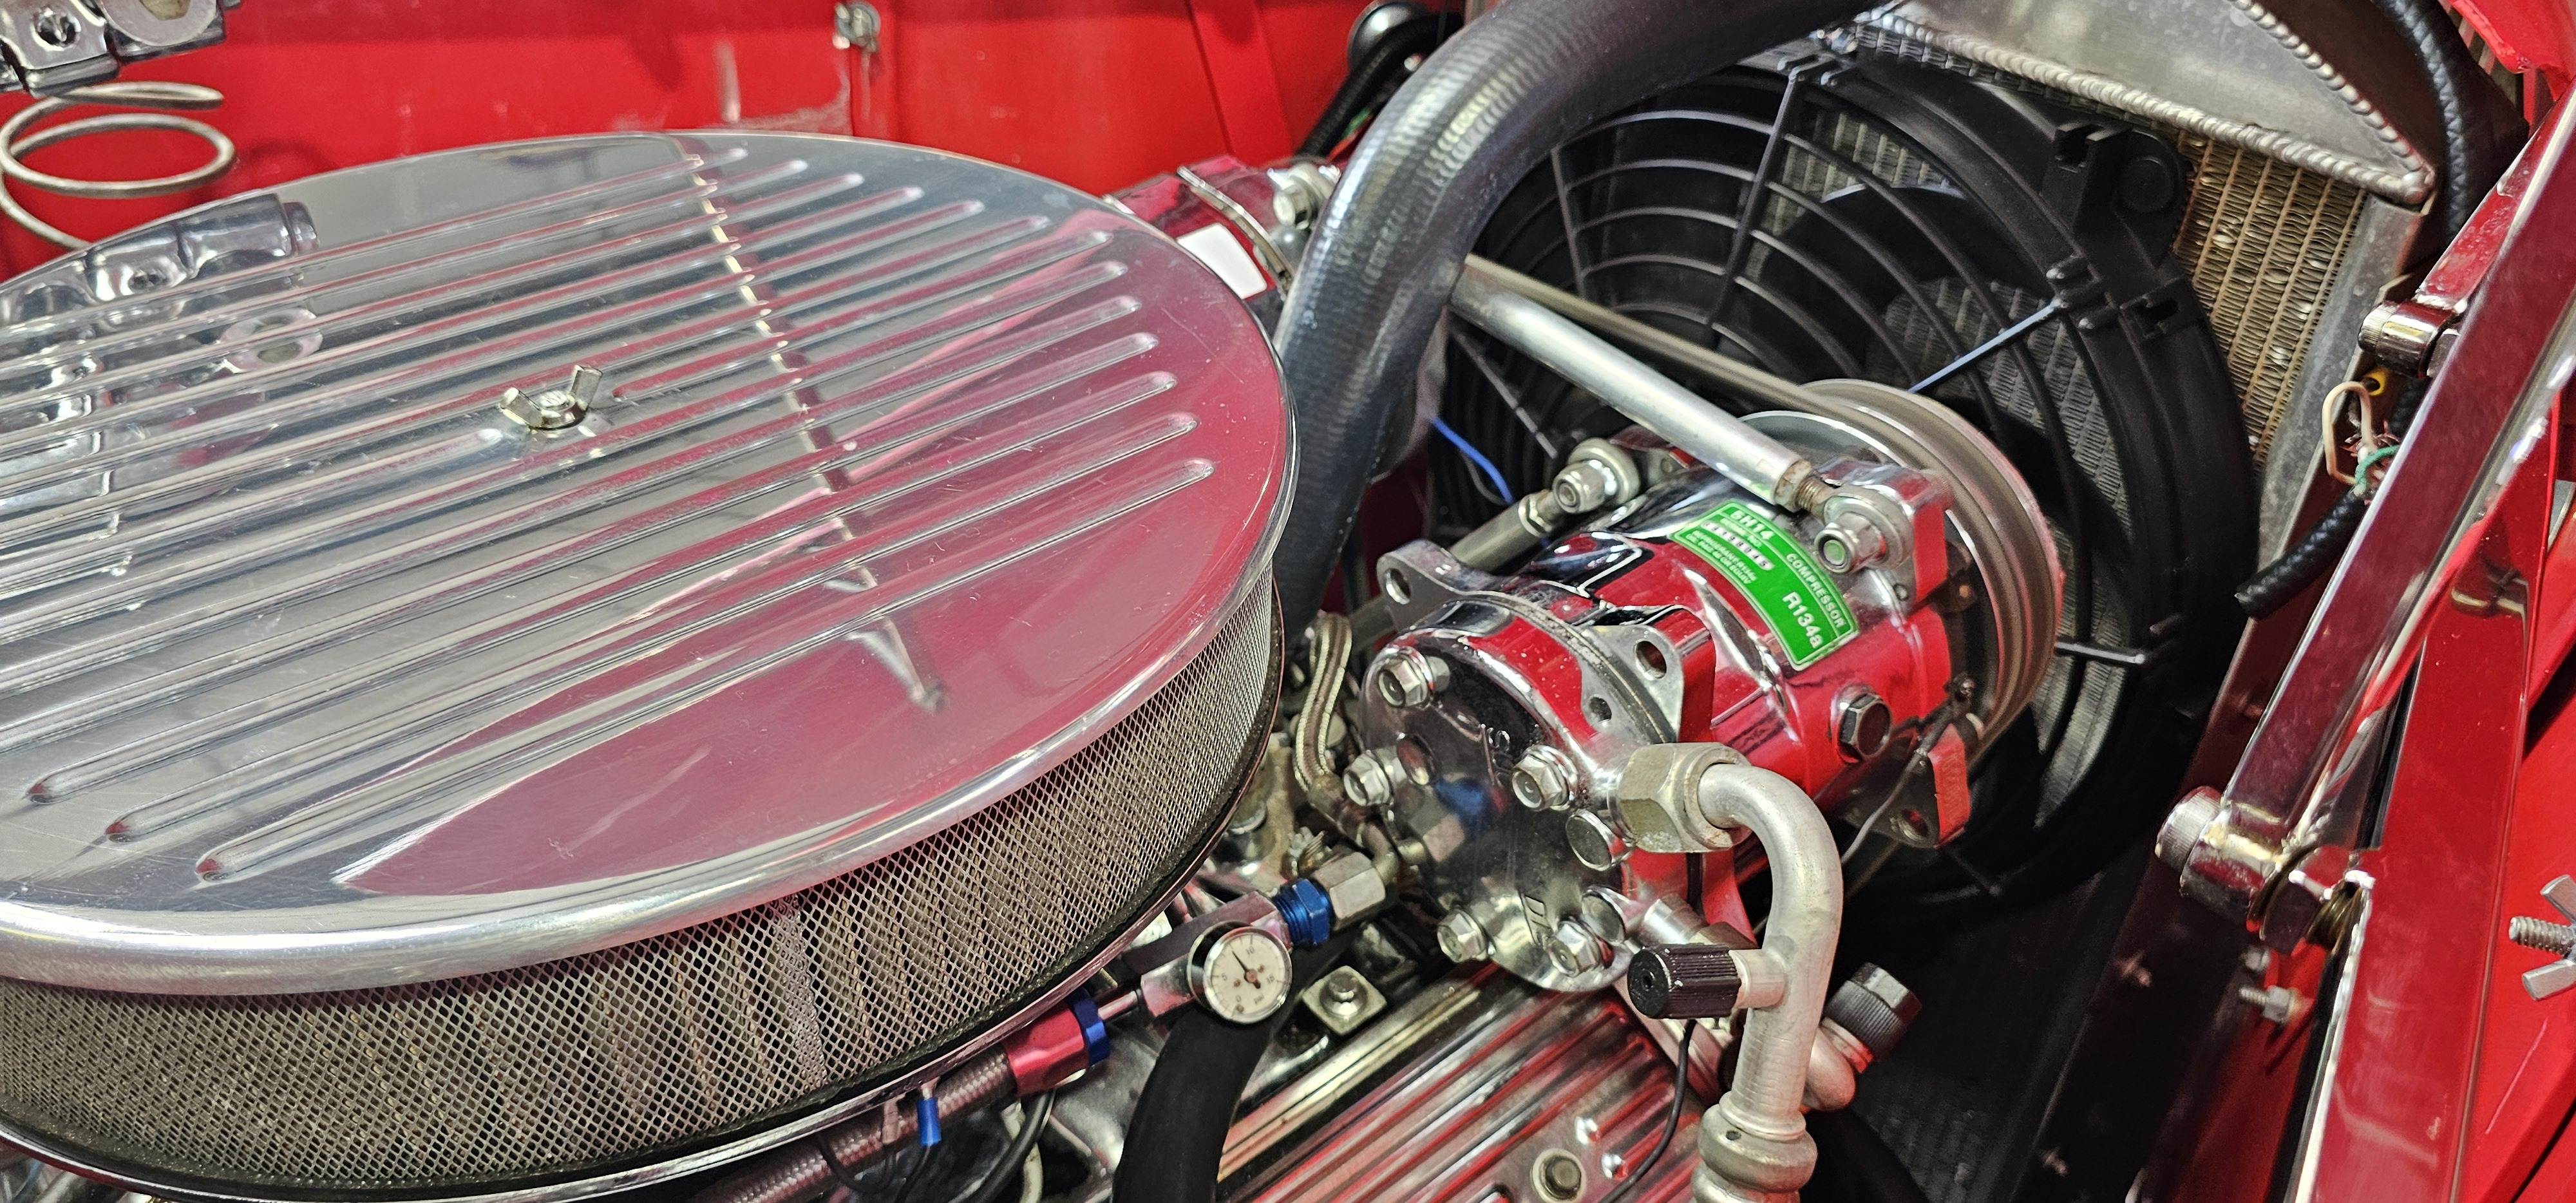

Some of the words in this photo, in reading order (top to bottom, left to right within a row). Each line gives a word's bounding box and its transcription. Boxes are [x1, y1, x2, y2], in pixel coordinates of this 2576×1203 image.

[1786, 553, 1846, 628] COMPRESSOR
[1783, 591, 1824, 649] R134a
[1245, 947, 1255, 956] 10
[1221, 973, 1228, 981] 5
[1266, 974, 1275, 985] 15
